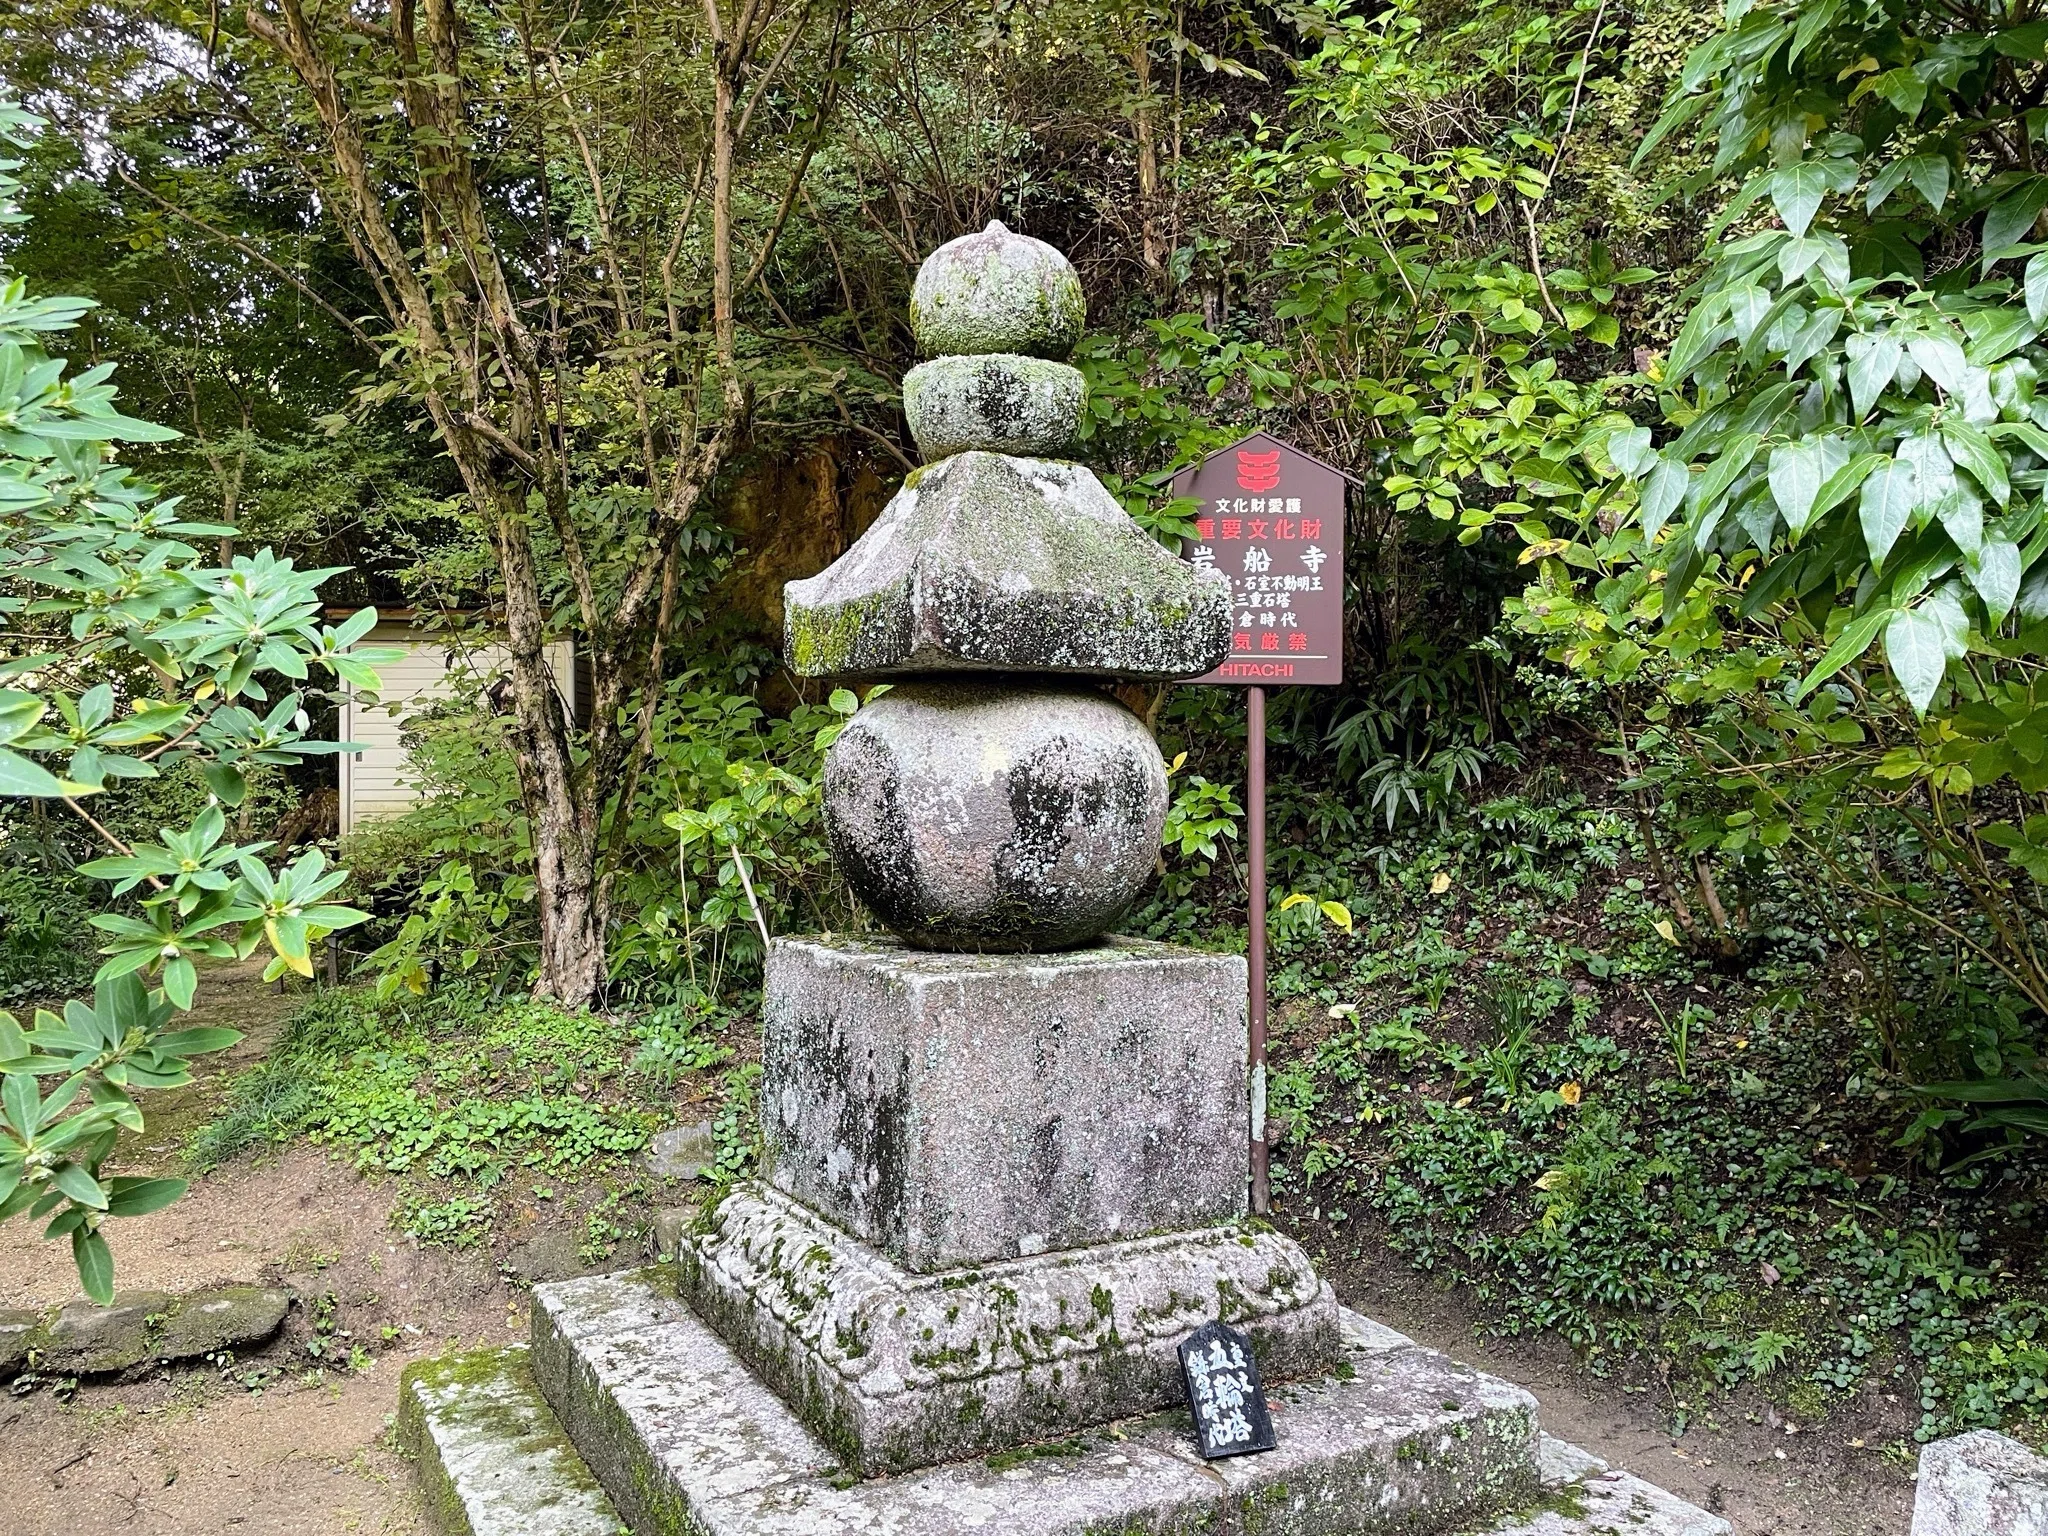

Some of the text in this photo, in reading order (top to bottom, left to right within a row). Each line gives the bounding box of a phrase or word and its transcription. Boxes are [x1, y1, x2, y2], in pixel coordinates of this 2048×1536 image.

[1216, 498, 1301, 513] 文化財愛護
[1196, 519, 1321, 540] 重要文化財
[1191, 545, 1327, 573] 岩船寺
[1226, 574, 1323, 592] ・石室不動明王
[1230, 611, 1297, 628] 倉時代
[1220, 663, 1294, 677] HITACHI
